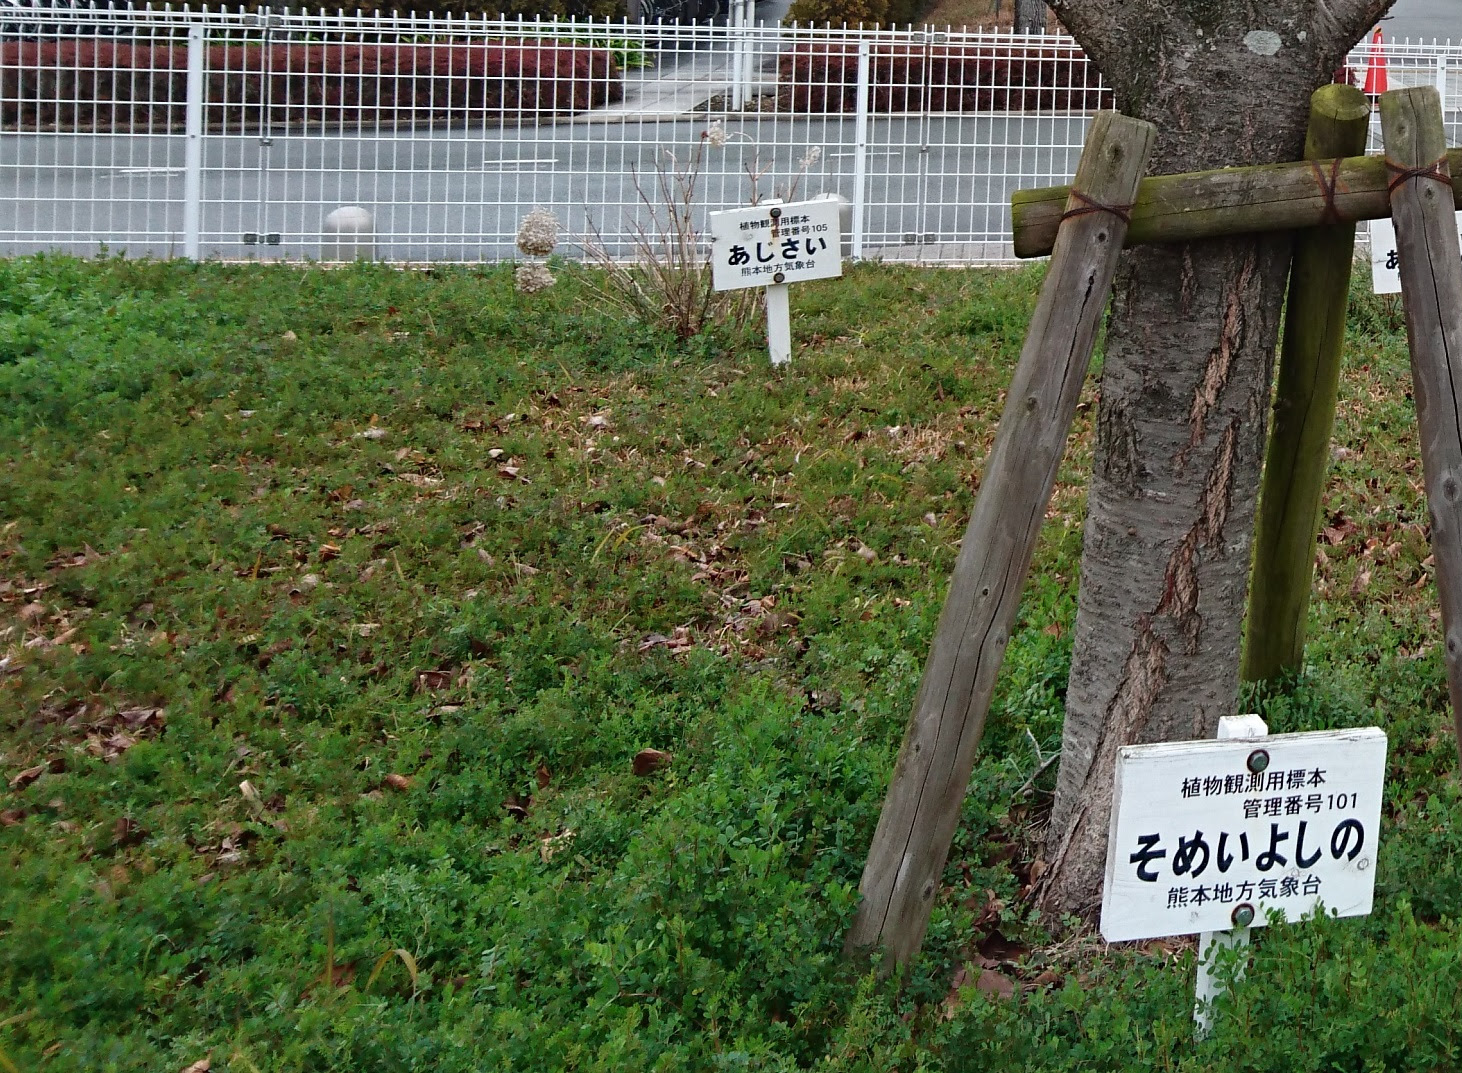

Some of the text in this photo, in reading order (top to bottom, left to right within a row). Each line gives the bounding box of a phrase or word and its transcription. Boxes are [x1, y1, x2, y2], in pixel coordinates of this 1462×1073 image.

[728, 237, 827, 265] あじさい
[741, 259, 816, 276] 熊本地方気象台
[1181, 768, 1327, 798] 植物観測用標本
[1243, 793, 1358, 819] 管理番号101
[1129, 818, 1365, 882] そめいよしの
[1167, 874, 1322, 908] 熊本地方気象台
